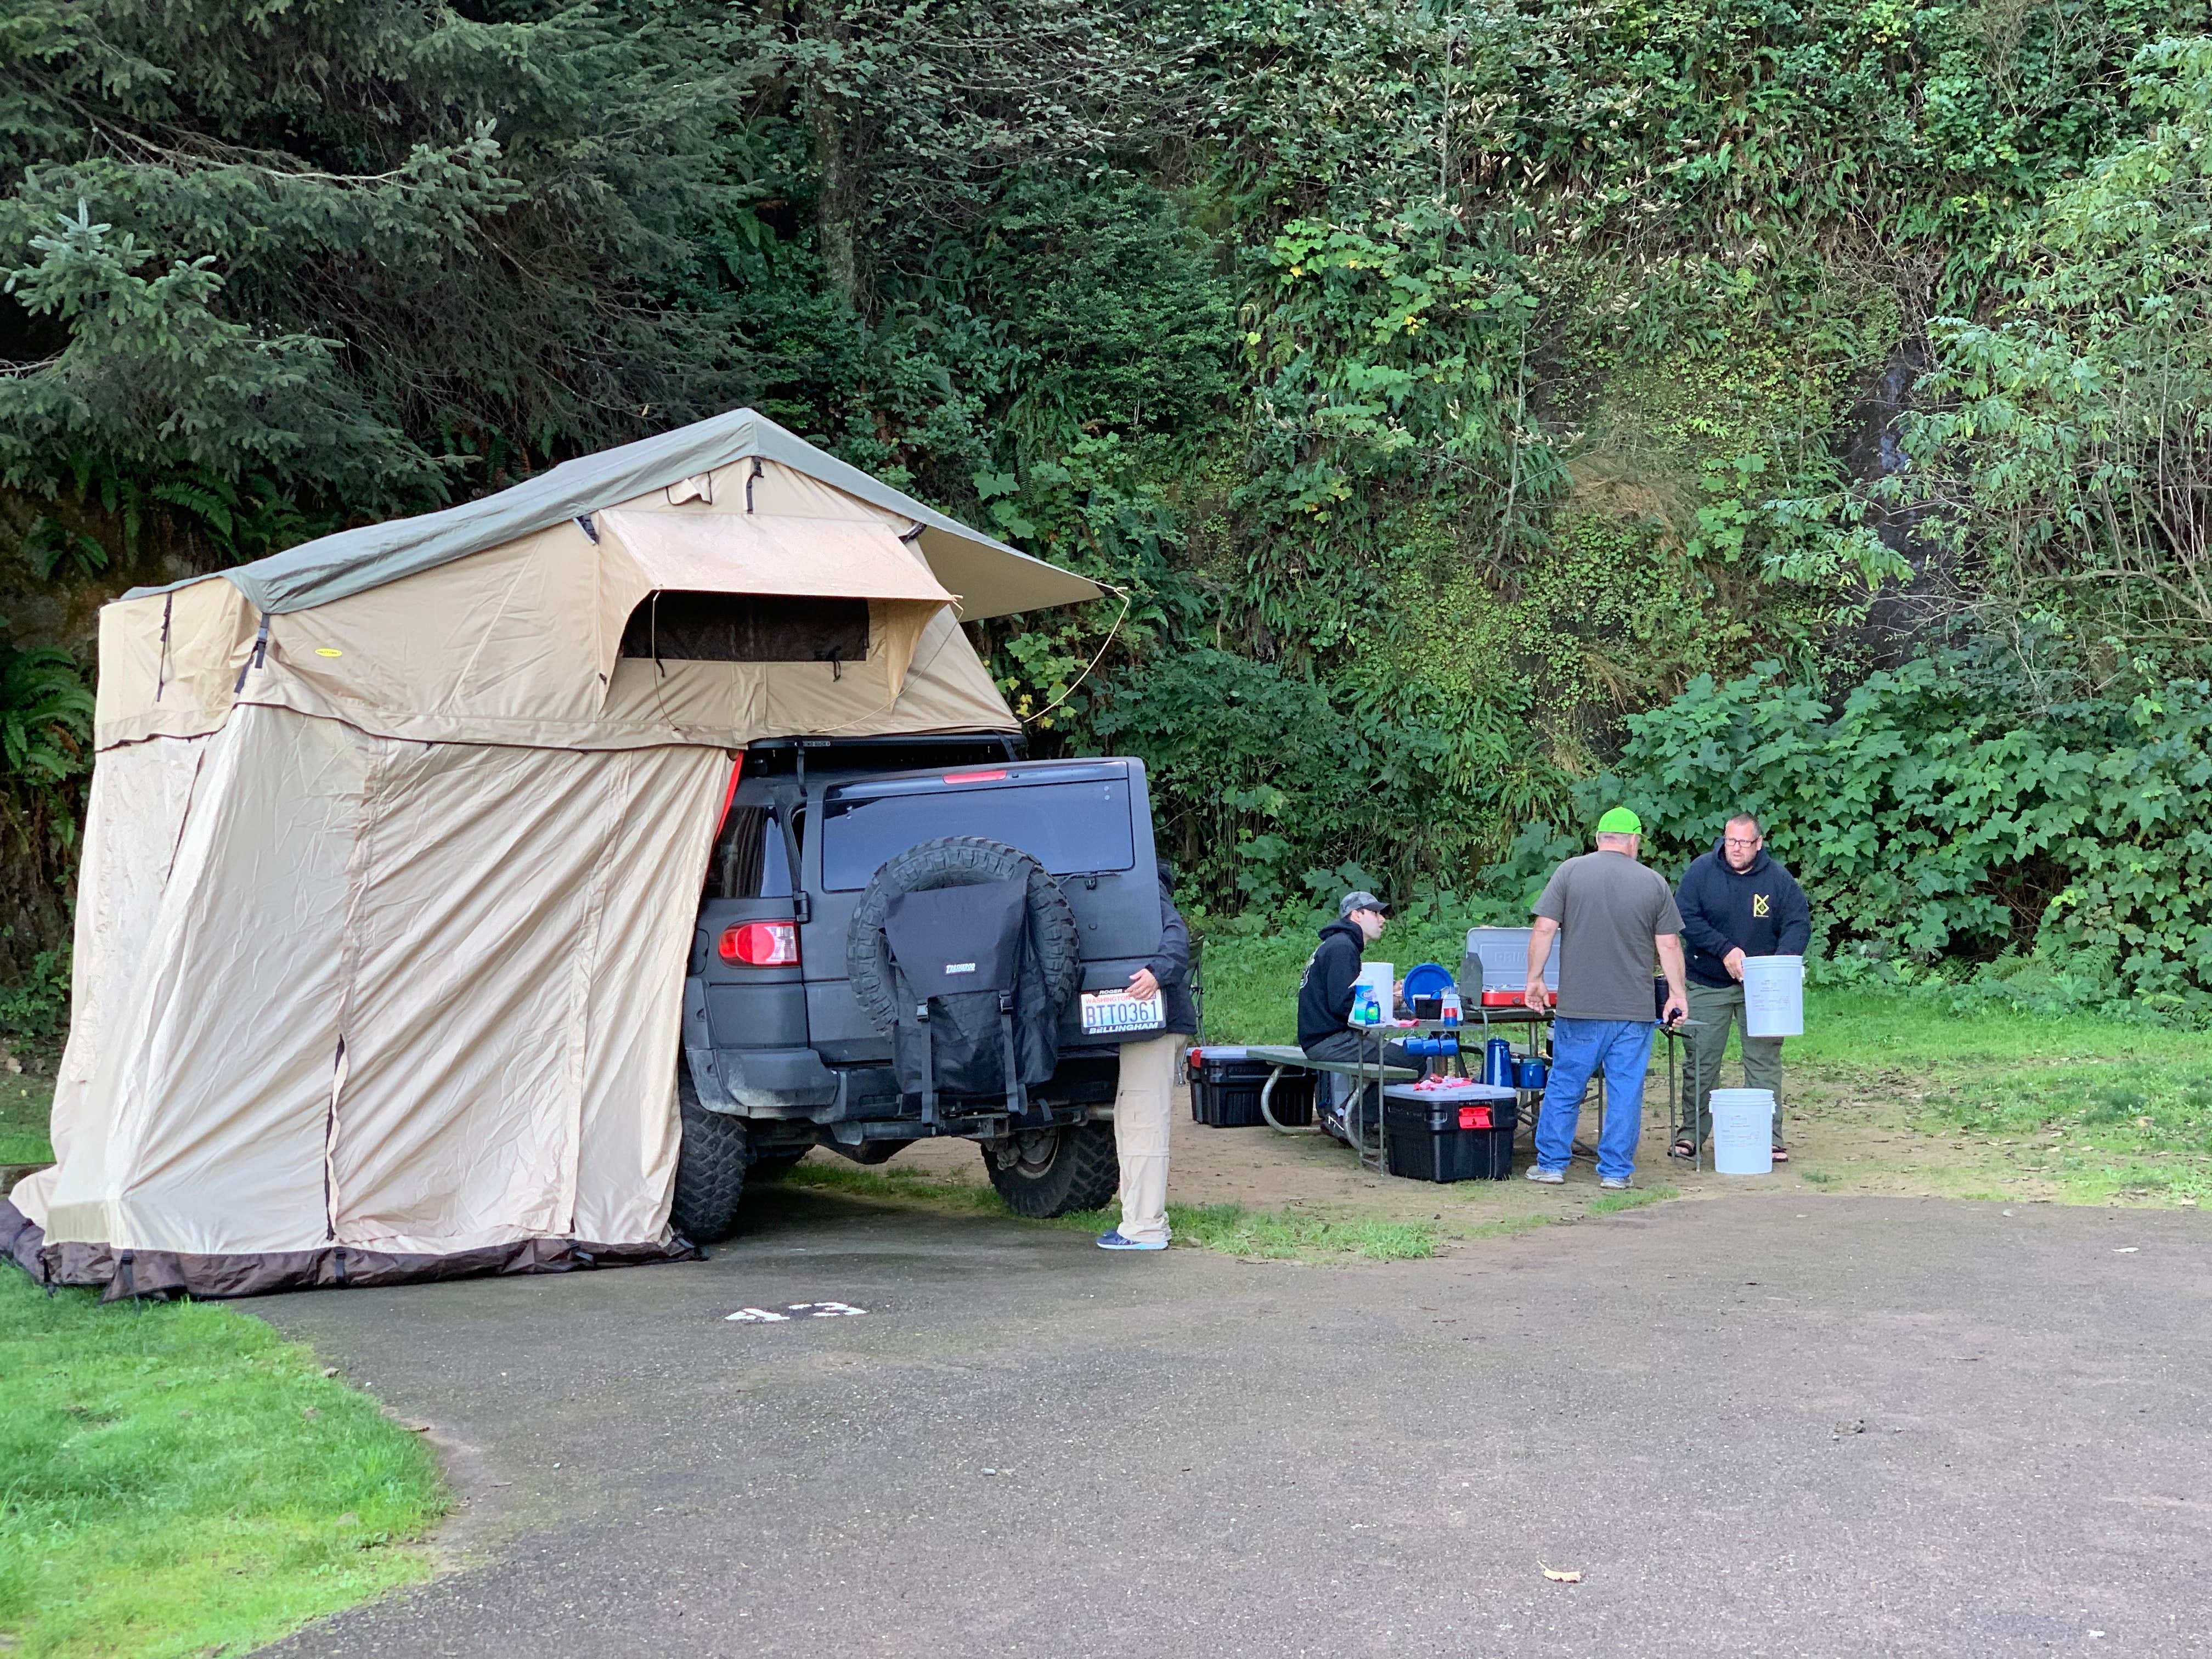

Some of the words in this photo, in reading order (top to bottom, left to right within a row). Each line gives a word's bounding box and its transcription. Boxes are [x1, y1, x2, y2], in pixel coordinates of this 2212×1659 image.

[1085, 995, 1131, 1004] WASHINGTON
[1086, 1000, 1157, 1026] BTT0361
[1089, 1022, 1158, 1034] BELLINGHAM
